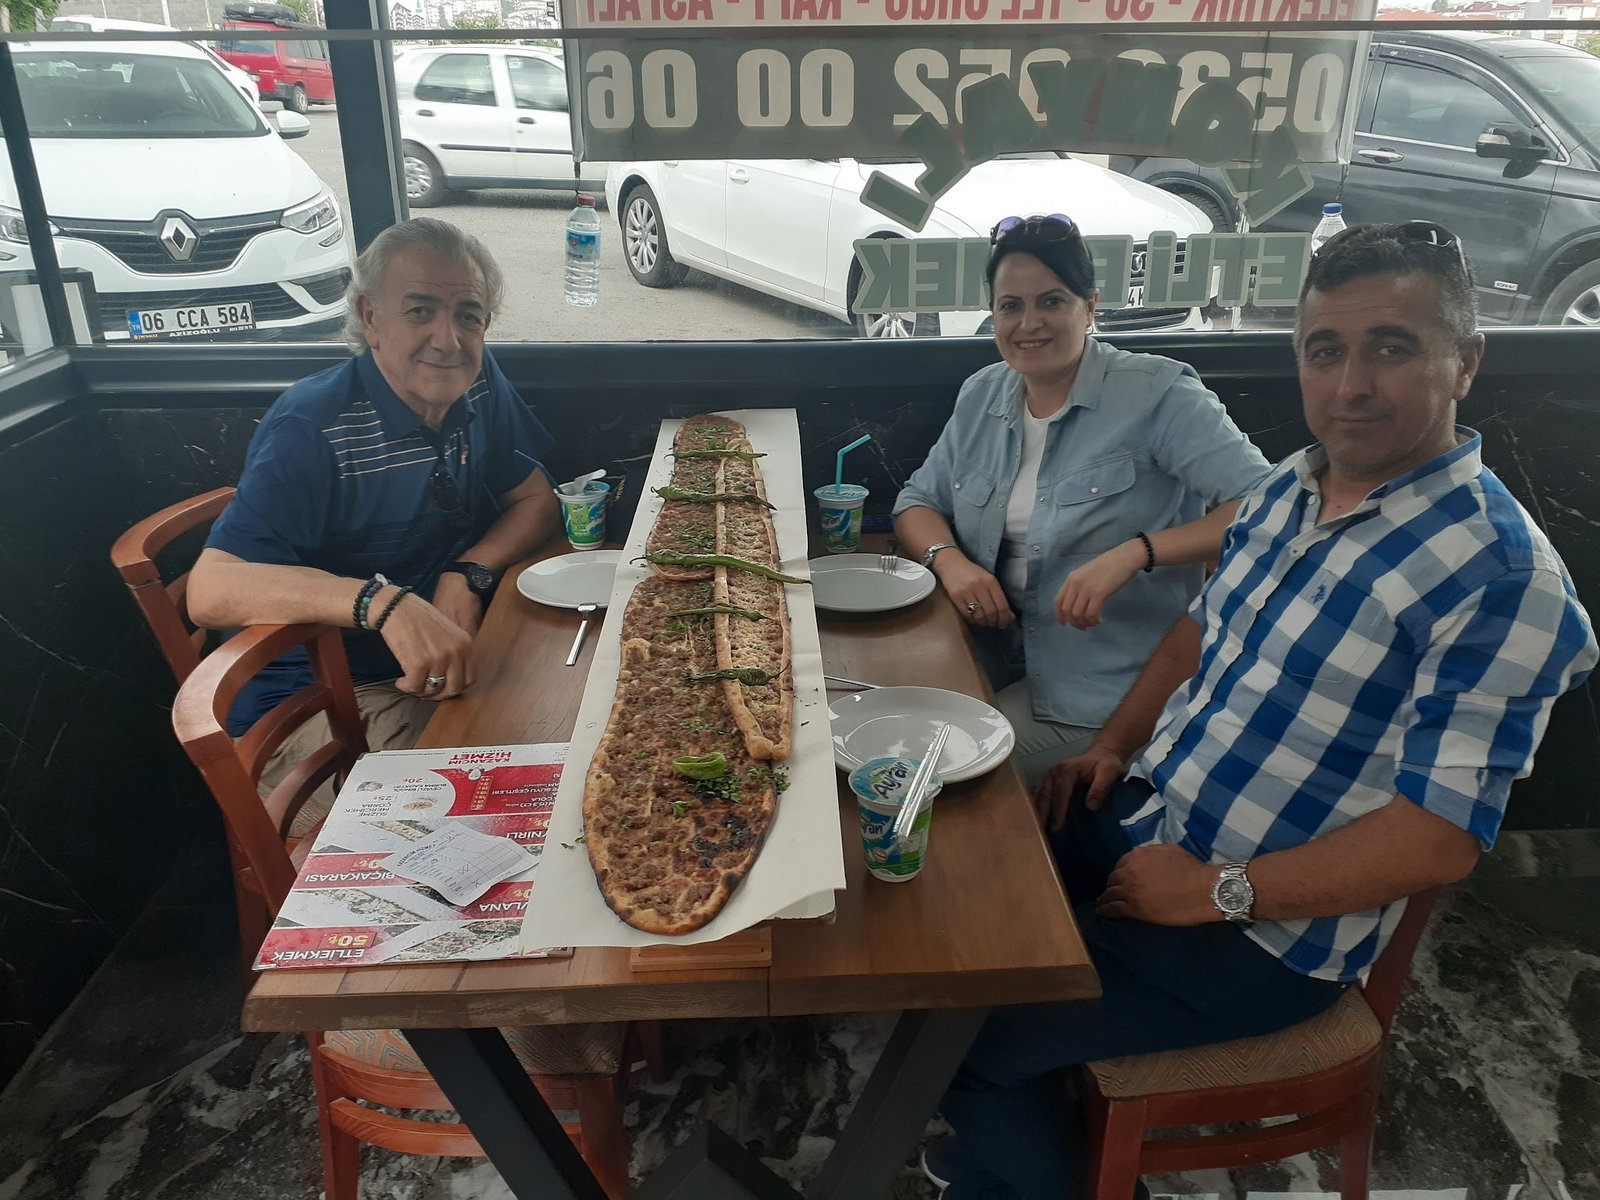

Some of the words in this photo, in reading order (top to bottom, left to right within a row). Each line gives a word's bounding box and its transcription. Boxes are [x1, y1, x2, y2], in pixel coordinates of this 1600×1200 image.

[142, 312, 164, 331] 06
[176, 308, 209, 328] CCA
[217, 305, 250, 325] 584
[874, 761, 911, 799] Ayran
